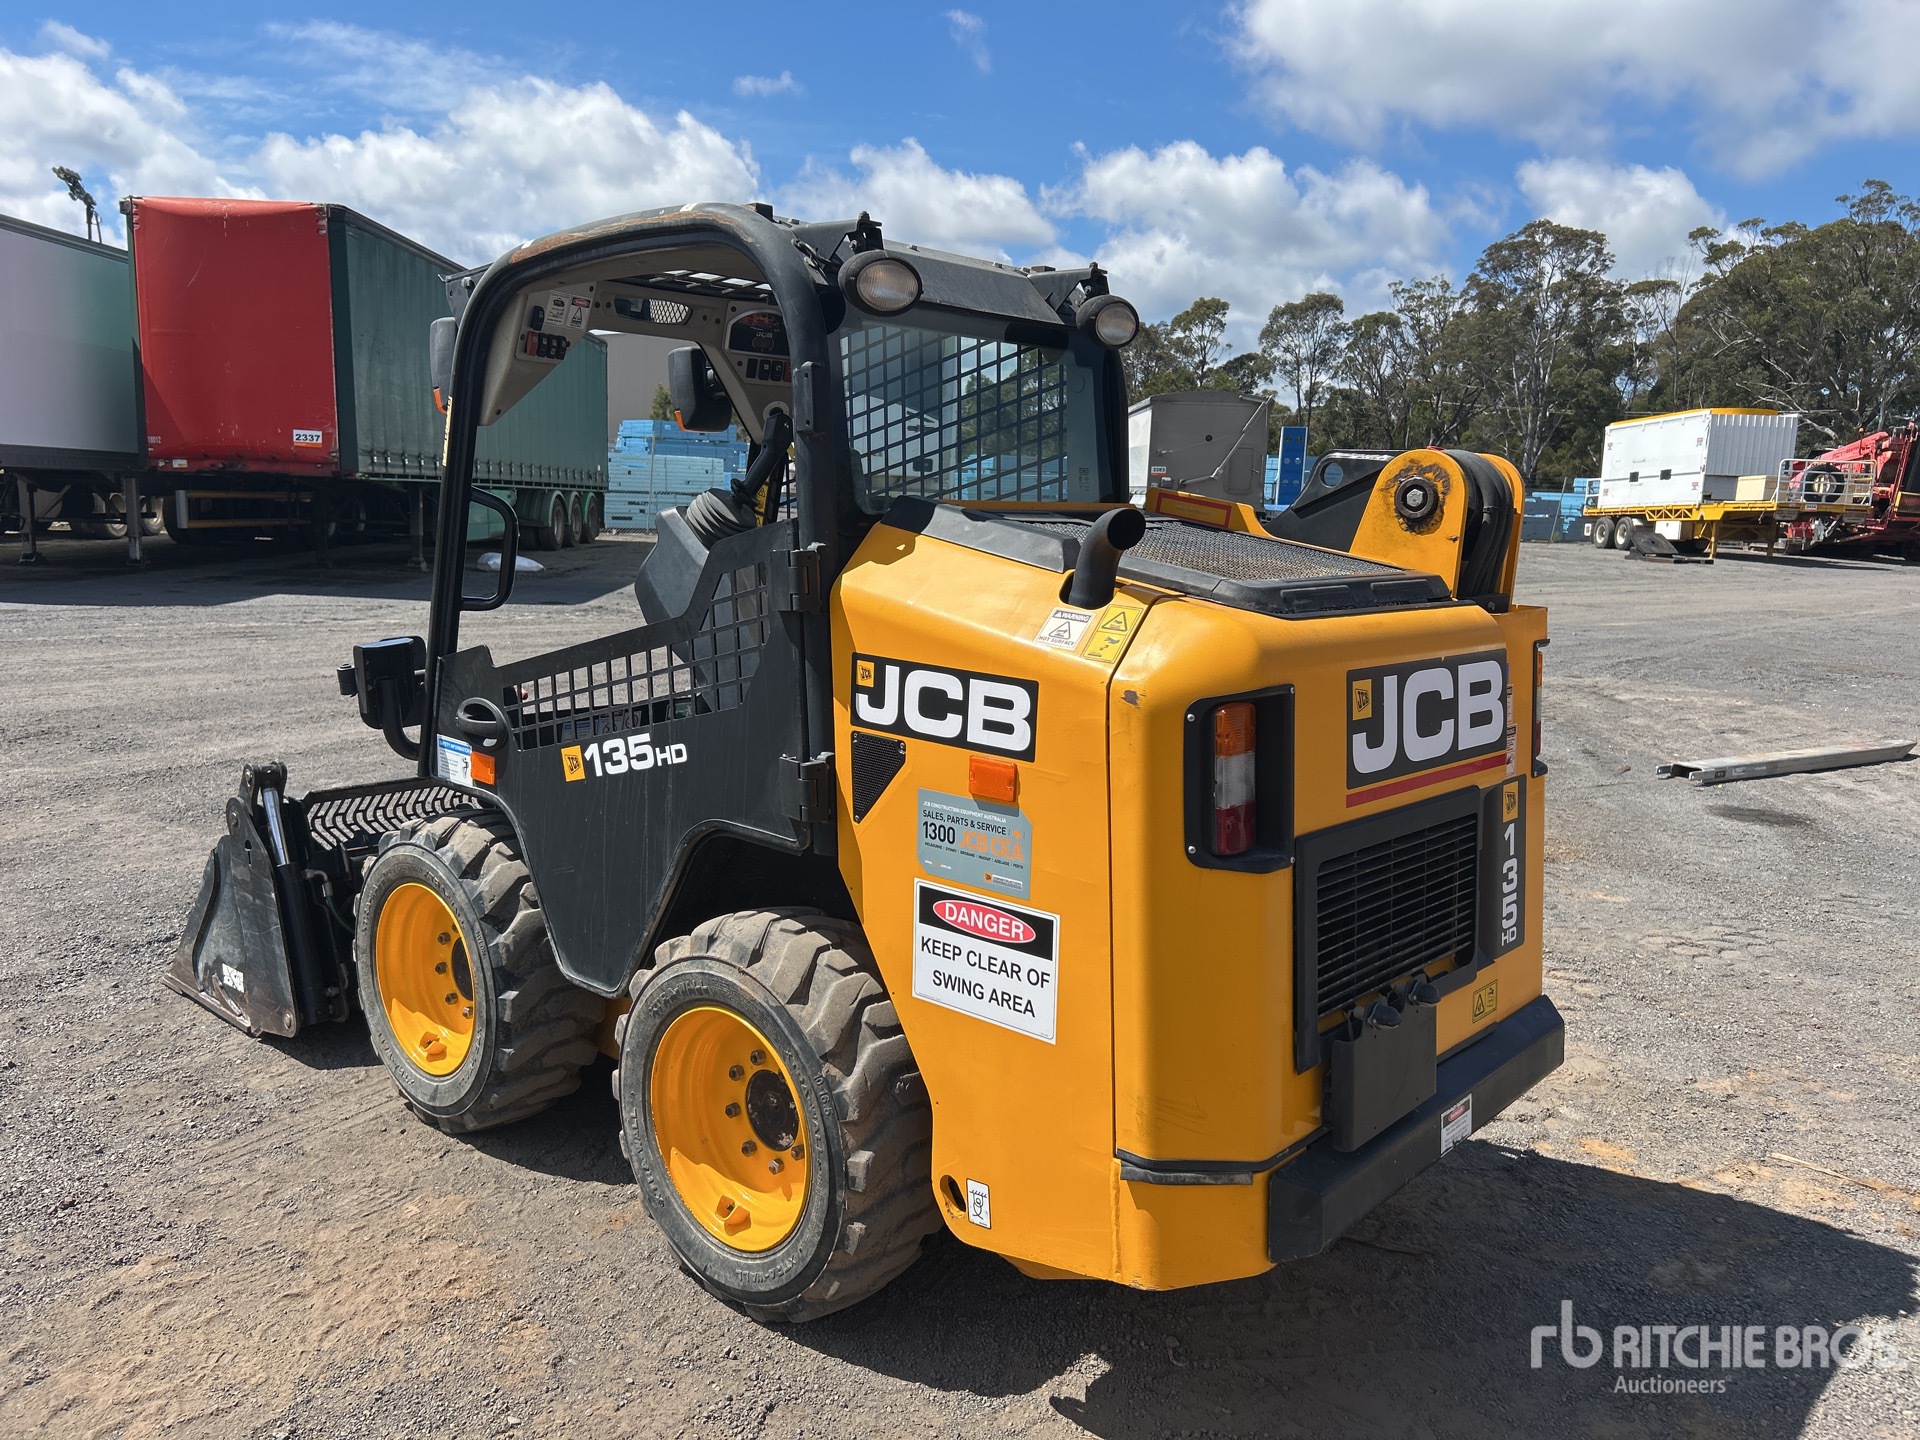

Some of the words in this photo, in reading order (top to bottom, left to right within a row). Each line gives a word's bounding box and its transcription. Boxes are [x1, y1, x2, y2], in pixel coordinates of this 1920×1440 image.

[295, 433, 321, 442] 2337
[1061, 611, 1090, 622] WARNING
[1051, 638, 1075, 646] SURFACE
[855, 664, 1031, 752] JCB
[1357, 691, 1370, 709] JCB
[1352, 660, 1504, 774] JCB
[567, 754, 580, 771] JCB
[930, 802, 960, 813] CONSTRUCTION
[960, 808, 984, 819] EQUIPMENT
[983, 813, 1007, 824] AUSTRALIA
[1505, 792, 1517, 812] JCB
[922, 809, 945, 823] SALES,
[946, 814, 969, 827] PARTS
[970, 819, 975, 828] &
[976, 822, 1007, 835] SERVICE
[922, 821, 956, 845] 1300
[958, 829, 988, 853] JCB
[991, 837, 1024, 862] CEA
[945, 902, 1024, 941] DANGER
[921, 936, 962, 961] KEEP
[966, 950, 1022, 982] CLEAR
[1026, 968, 1051, 989] OF
[932, 970, 984, 1000] SWING
[988, 988, 1035, 1018] AREA
